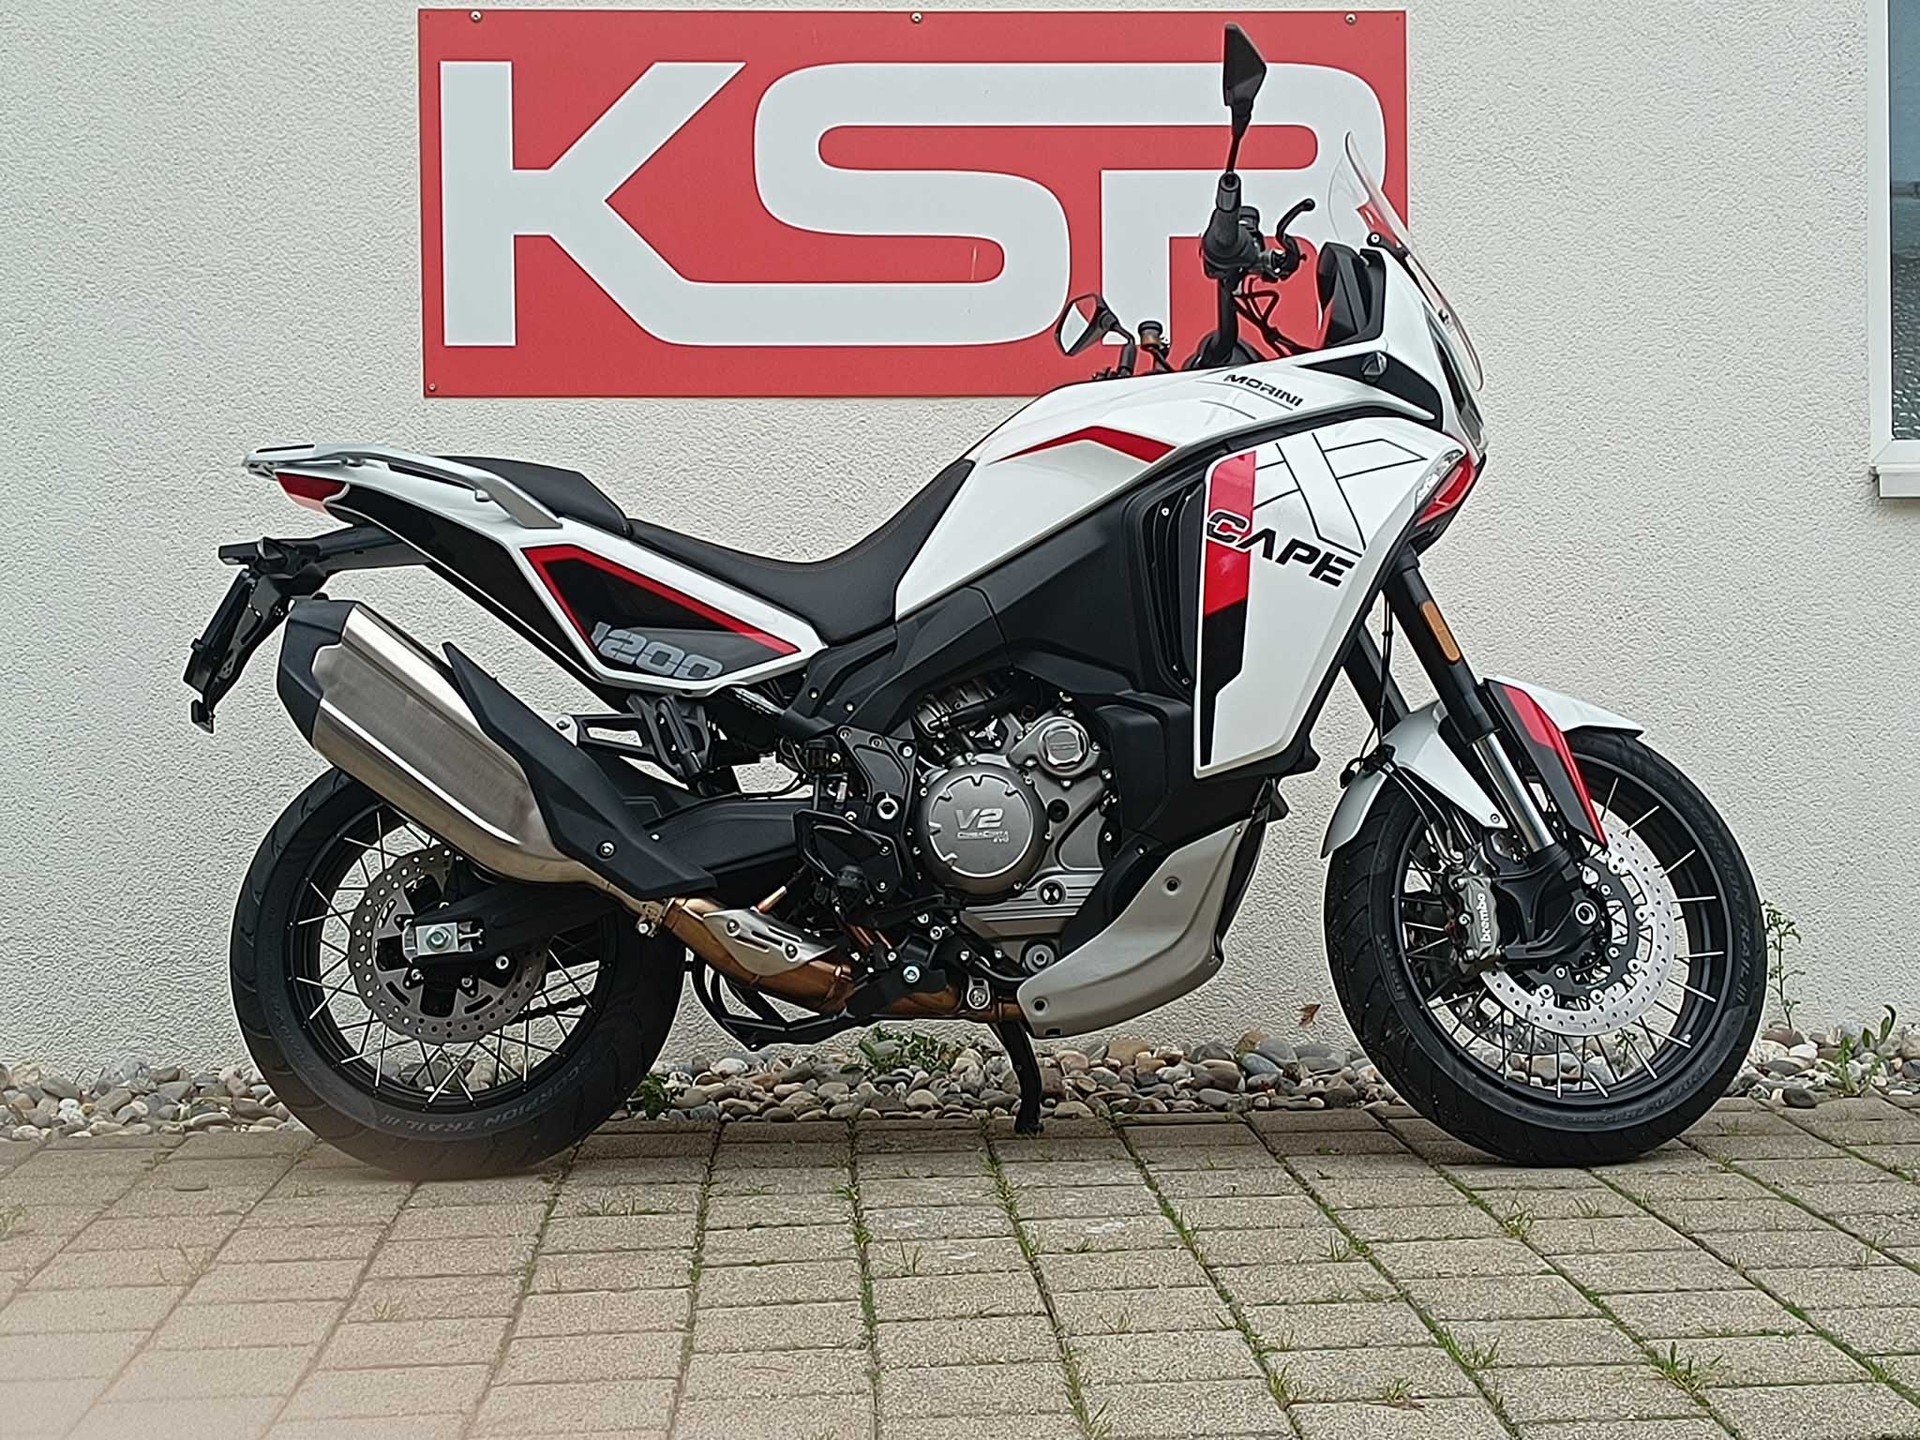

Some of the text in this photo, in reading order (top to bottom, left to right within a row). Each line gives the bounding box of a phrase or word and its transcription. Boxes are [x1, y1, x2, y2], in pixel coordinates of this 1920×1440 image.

[1223, 374, 1304, 407] MORINI
[1206, 511, 1355, 587] CAPE
[590, 621, 723, 679] 1200
[955, 807, 1003, 829] V2
[1476, 892, 1492, 942] brembo
